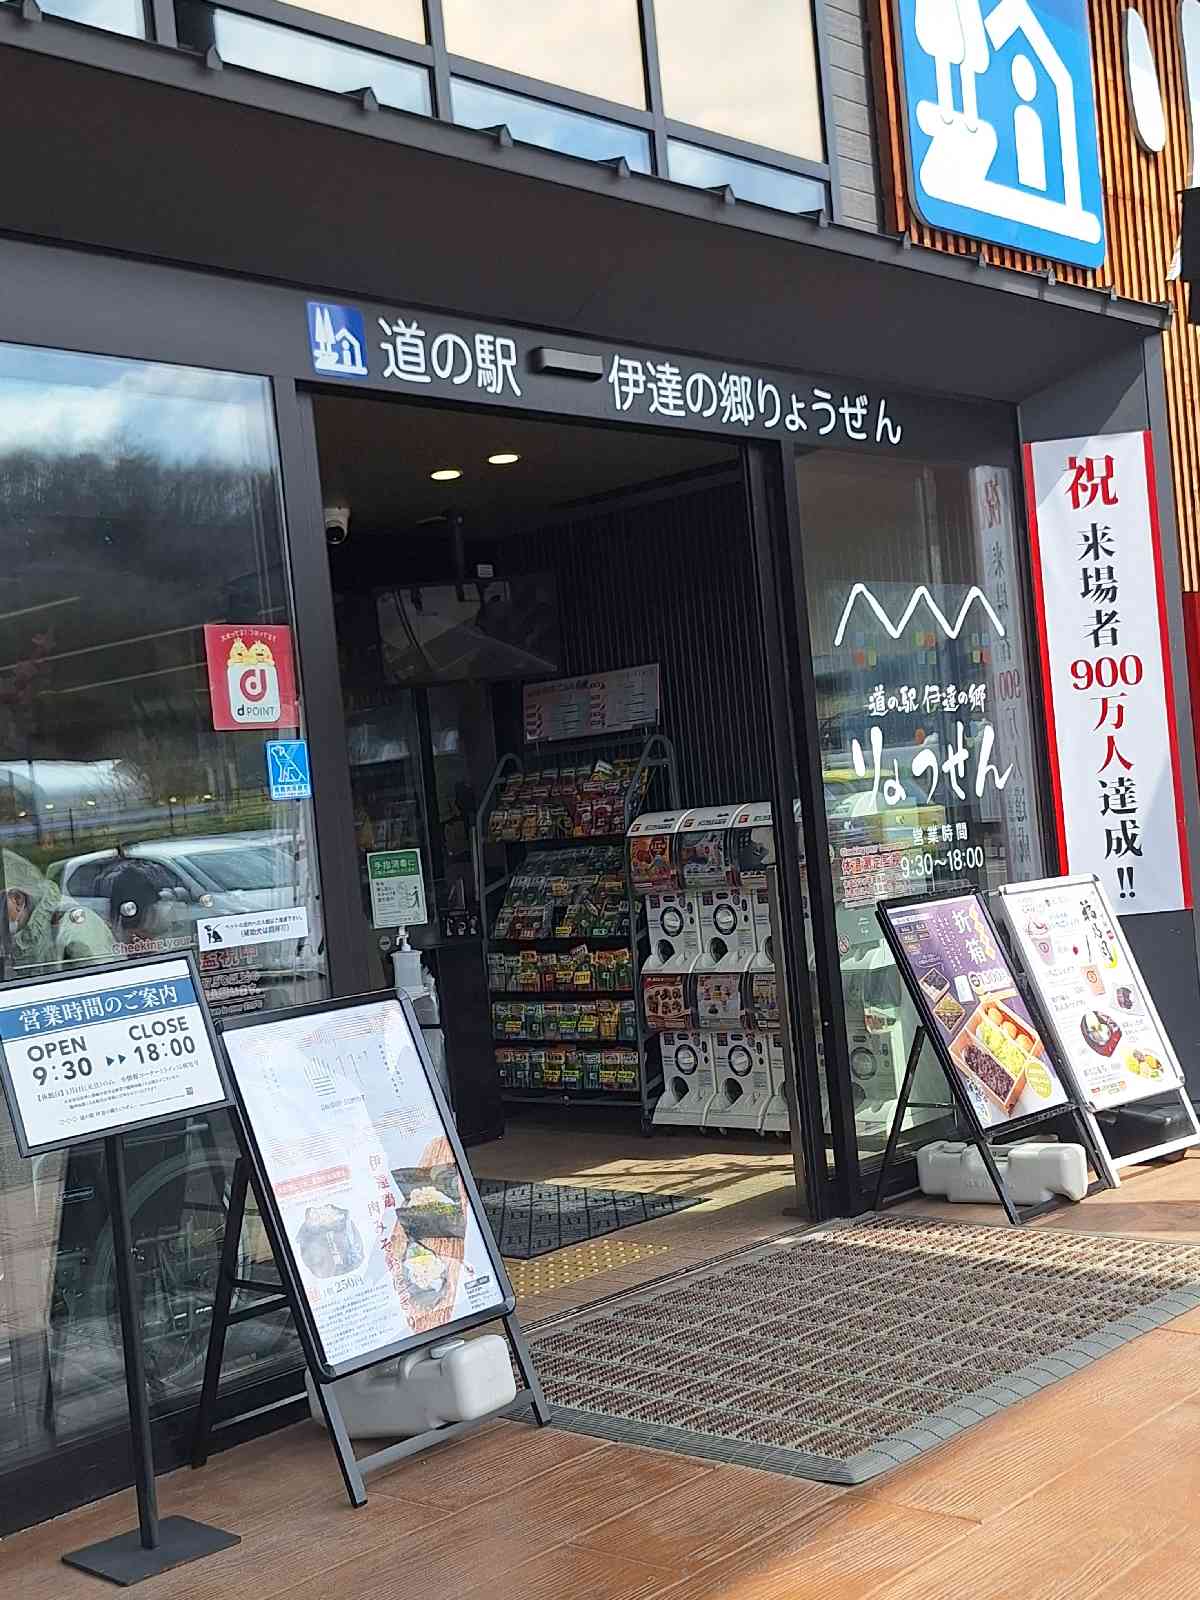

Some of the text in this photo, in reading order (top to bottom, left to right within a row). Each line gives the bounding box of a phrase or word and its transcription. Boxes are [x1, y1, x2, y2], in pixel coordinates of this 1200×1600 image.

[378, 317, 903, 446] 道の駅 伊達の郷りょうぜん
[1064, 454, 1120, 510] 祝
[246, 705, 276, 717] POINT
[867, 683, 987, 717] 道の駅 伊達の郷
[912, 822, 968, 846] 営業時間
[19, 984, 178, 1033] 営業時間のご案内
[128, 1015, 189, 1041] CLOSE
[27, 1035, 88, 1062] OPEN
[133, 1035, 197, 1065] 18:00
[32, 1056, 93, 1086] 9:30
